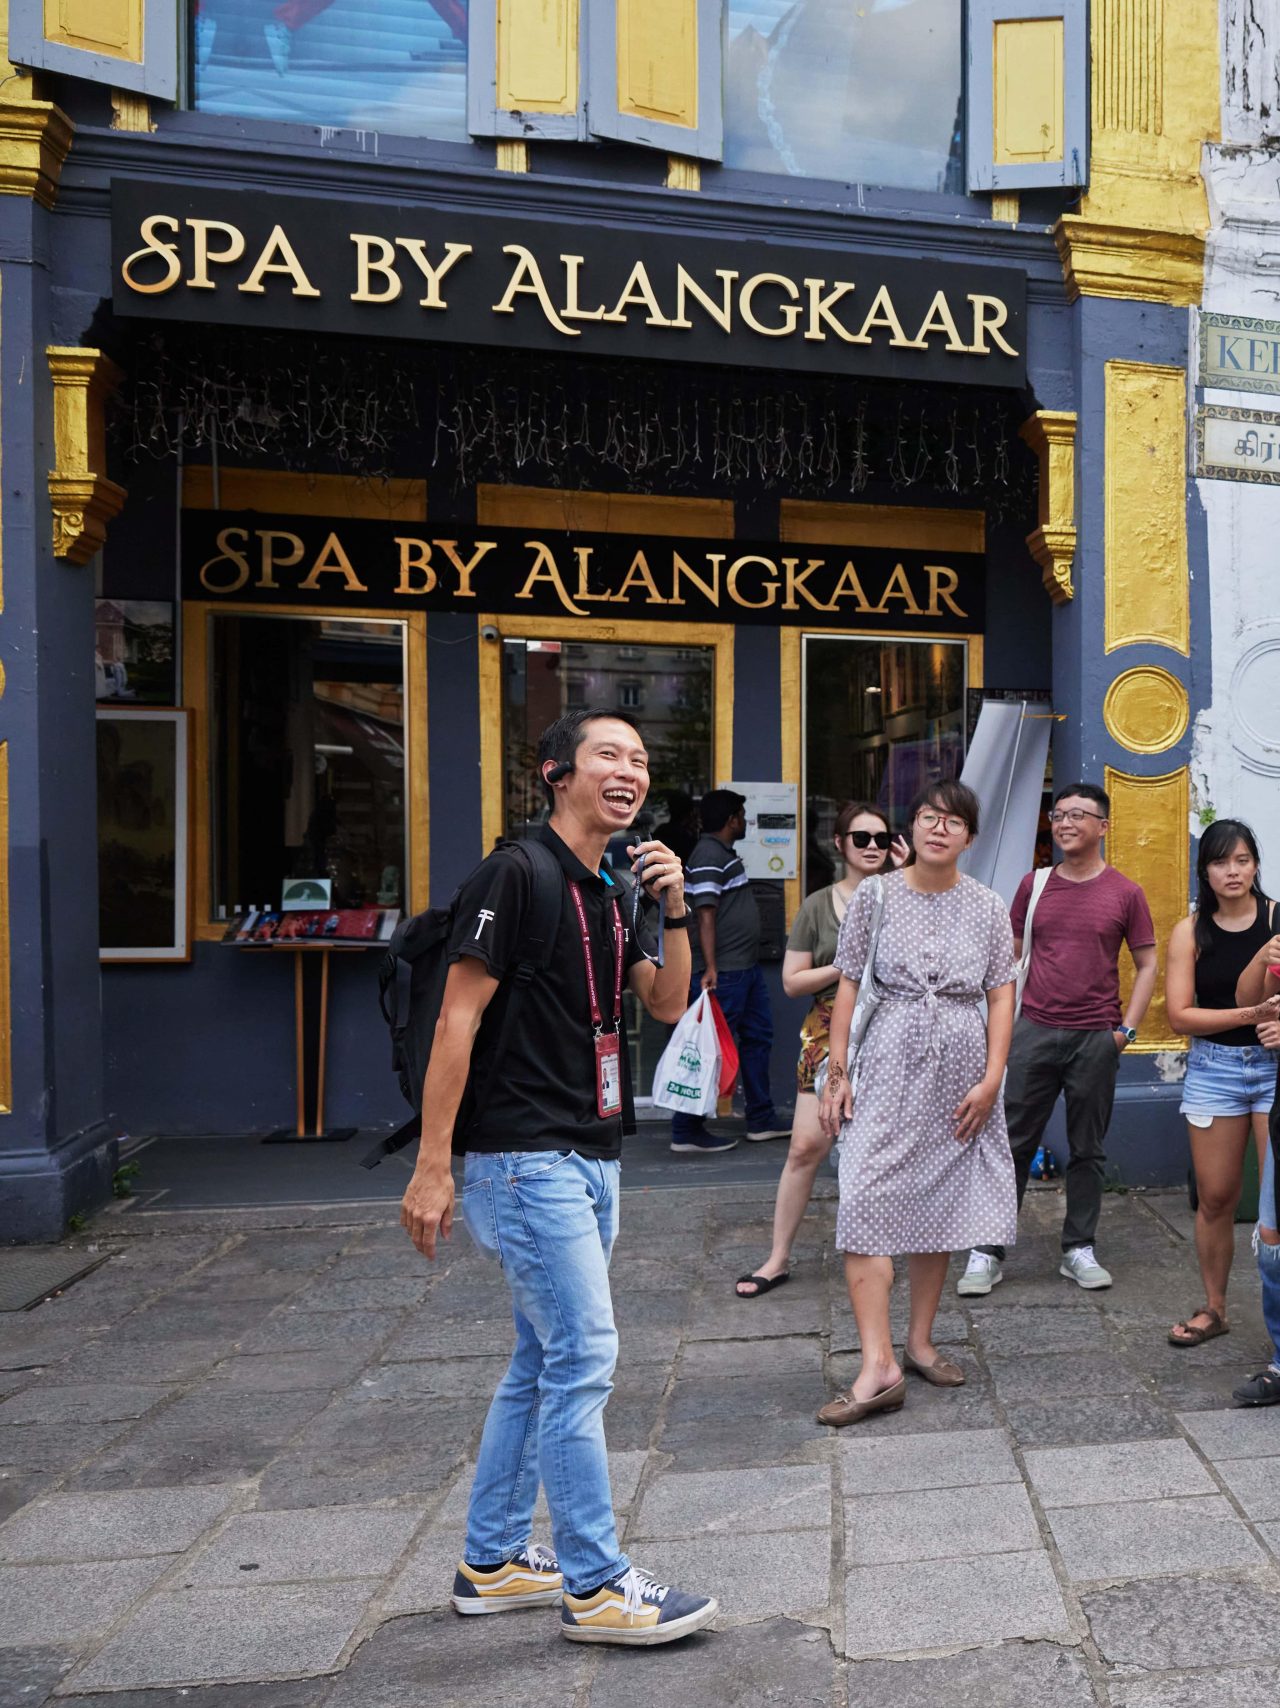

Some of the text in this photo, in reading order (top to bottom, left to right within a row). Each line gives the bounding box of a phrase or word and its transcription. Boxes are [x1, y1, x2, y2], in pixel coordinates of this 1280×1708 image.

[121, 214, 1020, 357] SPA BY ALANGKAAR
[200, 527, 969, 618] SPA BY ALANGKAAR
